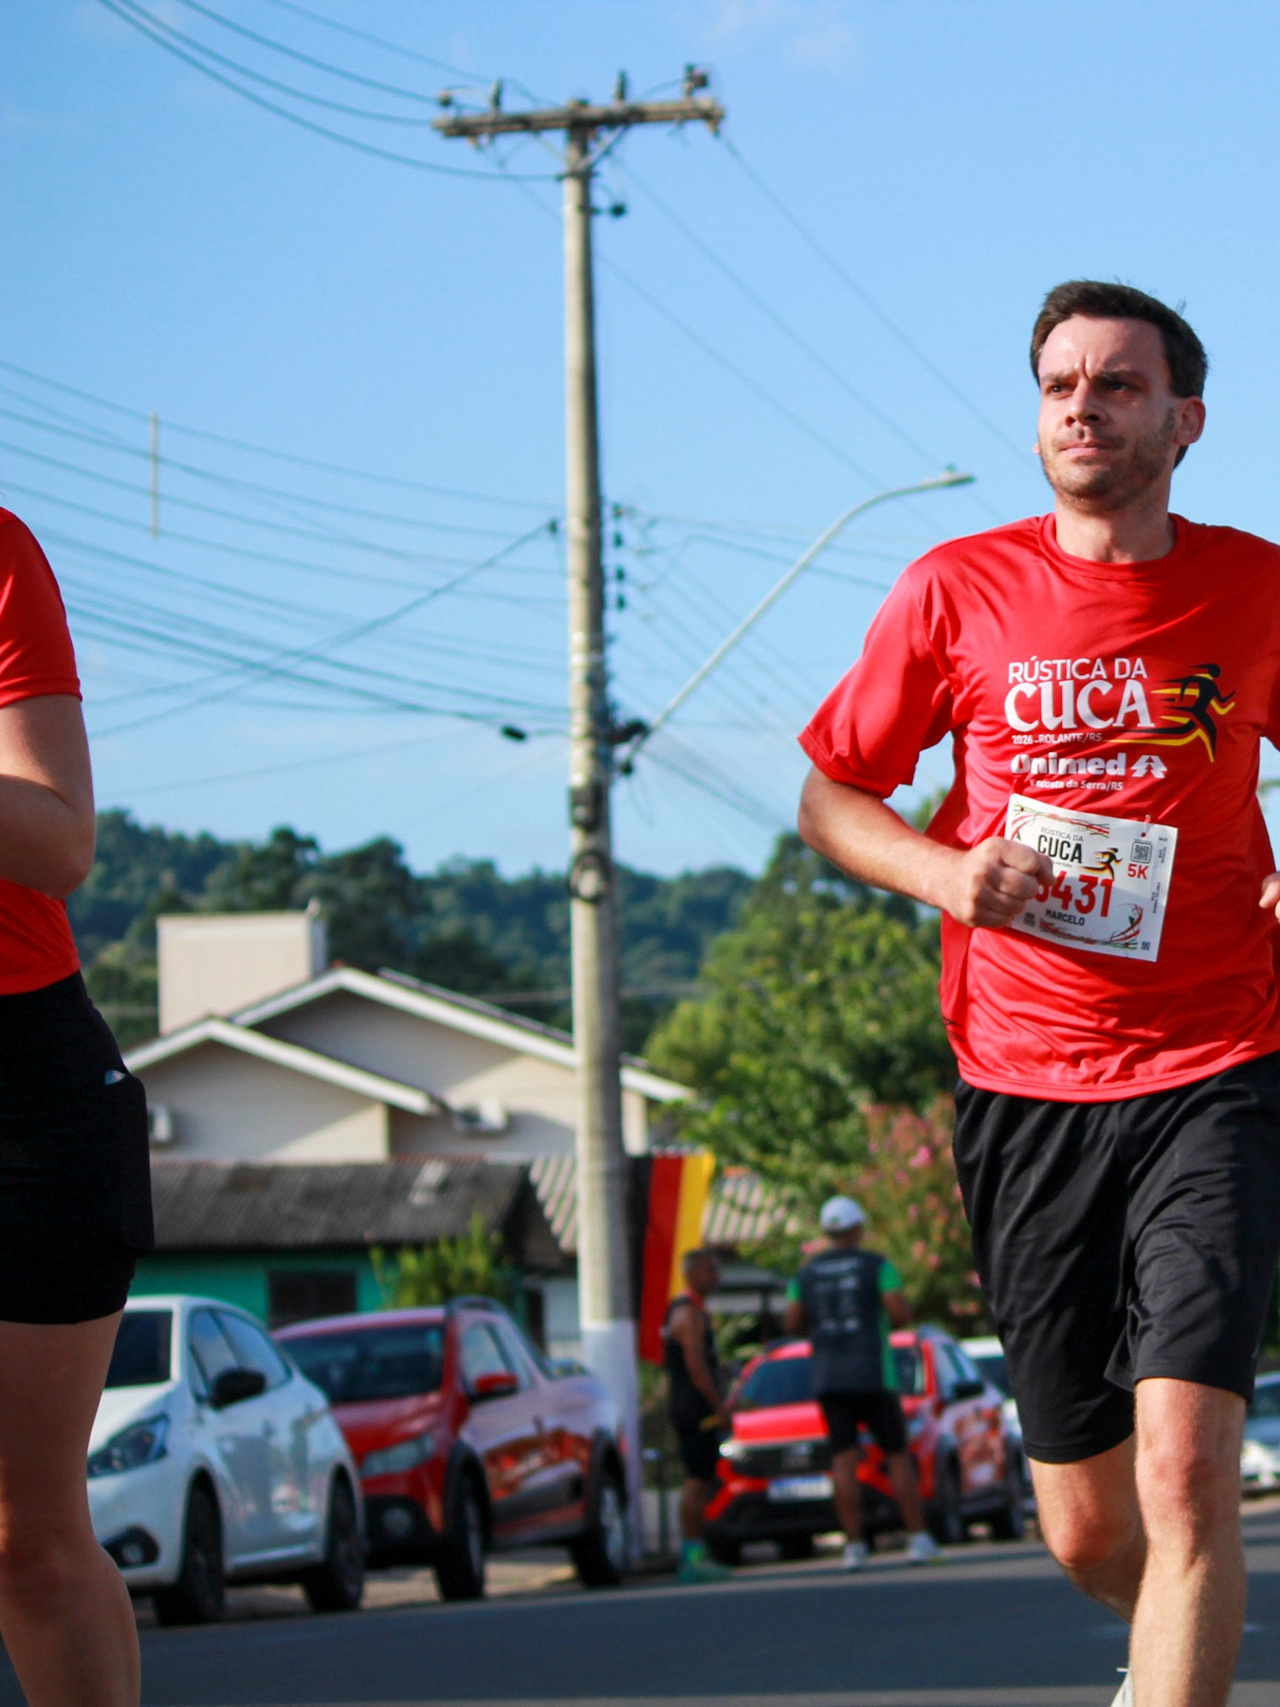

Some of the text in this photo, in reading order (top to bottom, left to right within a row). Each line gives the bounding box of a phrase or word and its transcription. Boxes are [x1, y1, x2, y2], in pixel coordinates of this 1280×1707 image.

[1008, 655, 1148, 684] RÚSTICA DA
[1004, 679, 1155, 732] CUCA
[1010, 751, 1127, 776] Unimed
[1080, 780, 1124, 791] Serra/RS
[1037, 834, 1083, 864] CUCA
[1072, 834, 1084, 843] DA
[1127, 863, 1149, 880] 5K
[1045, 908, 1085, 926] MARCELO
